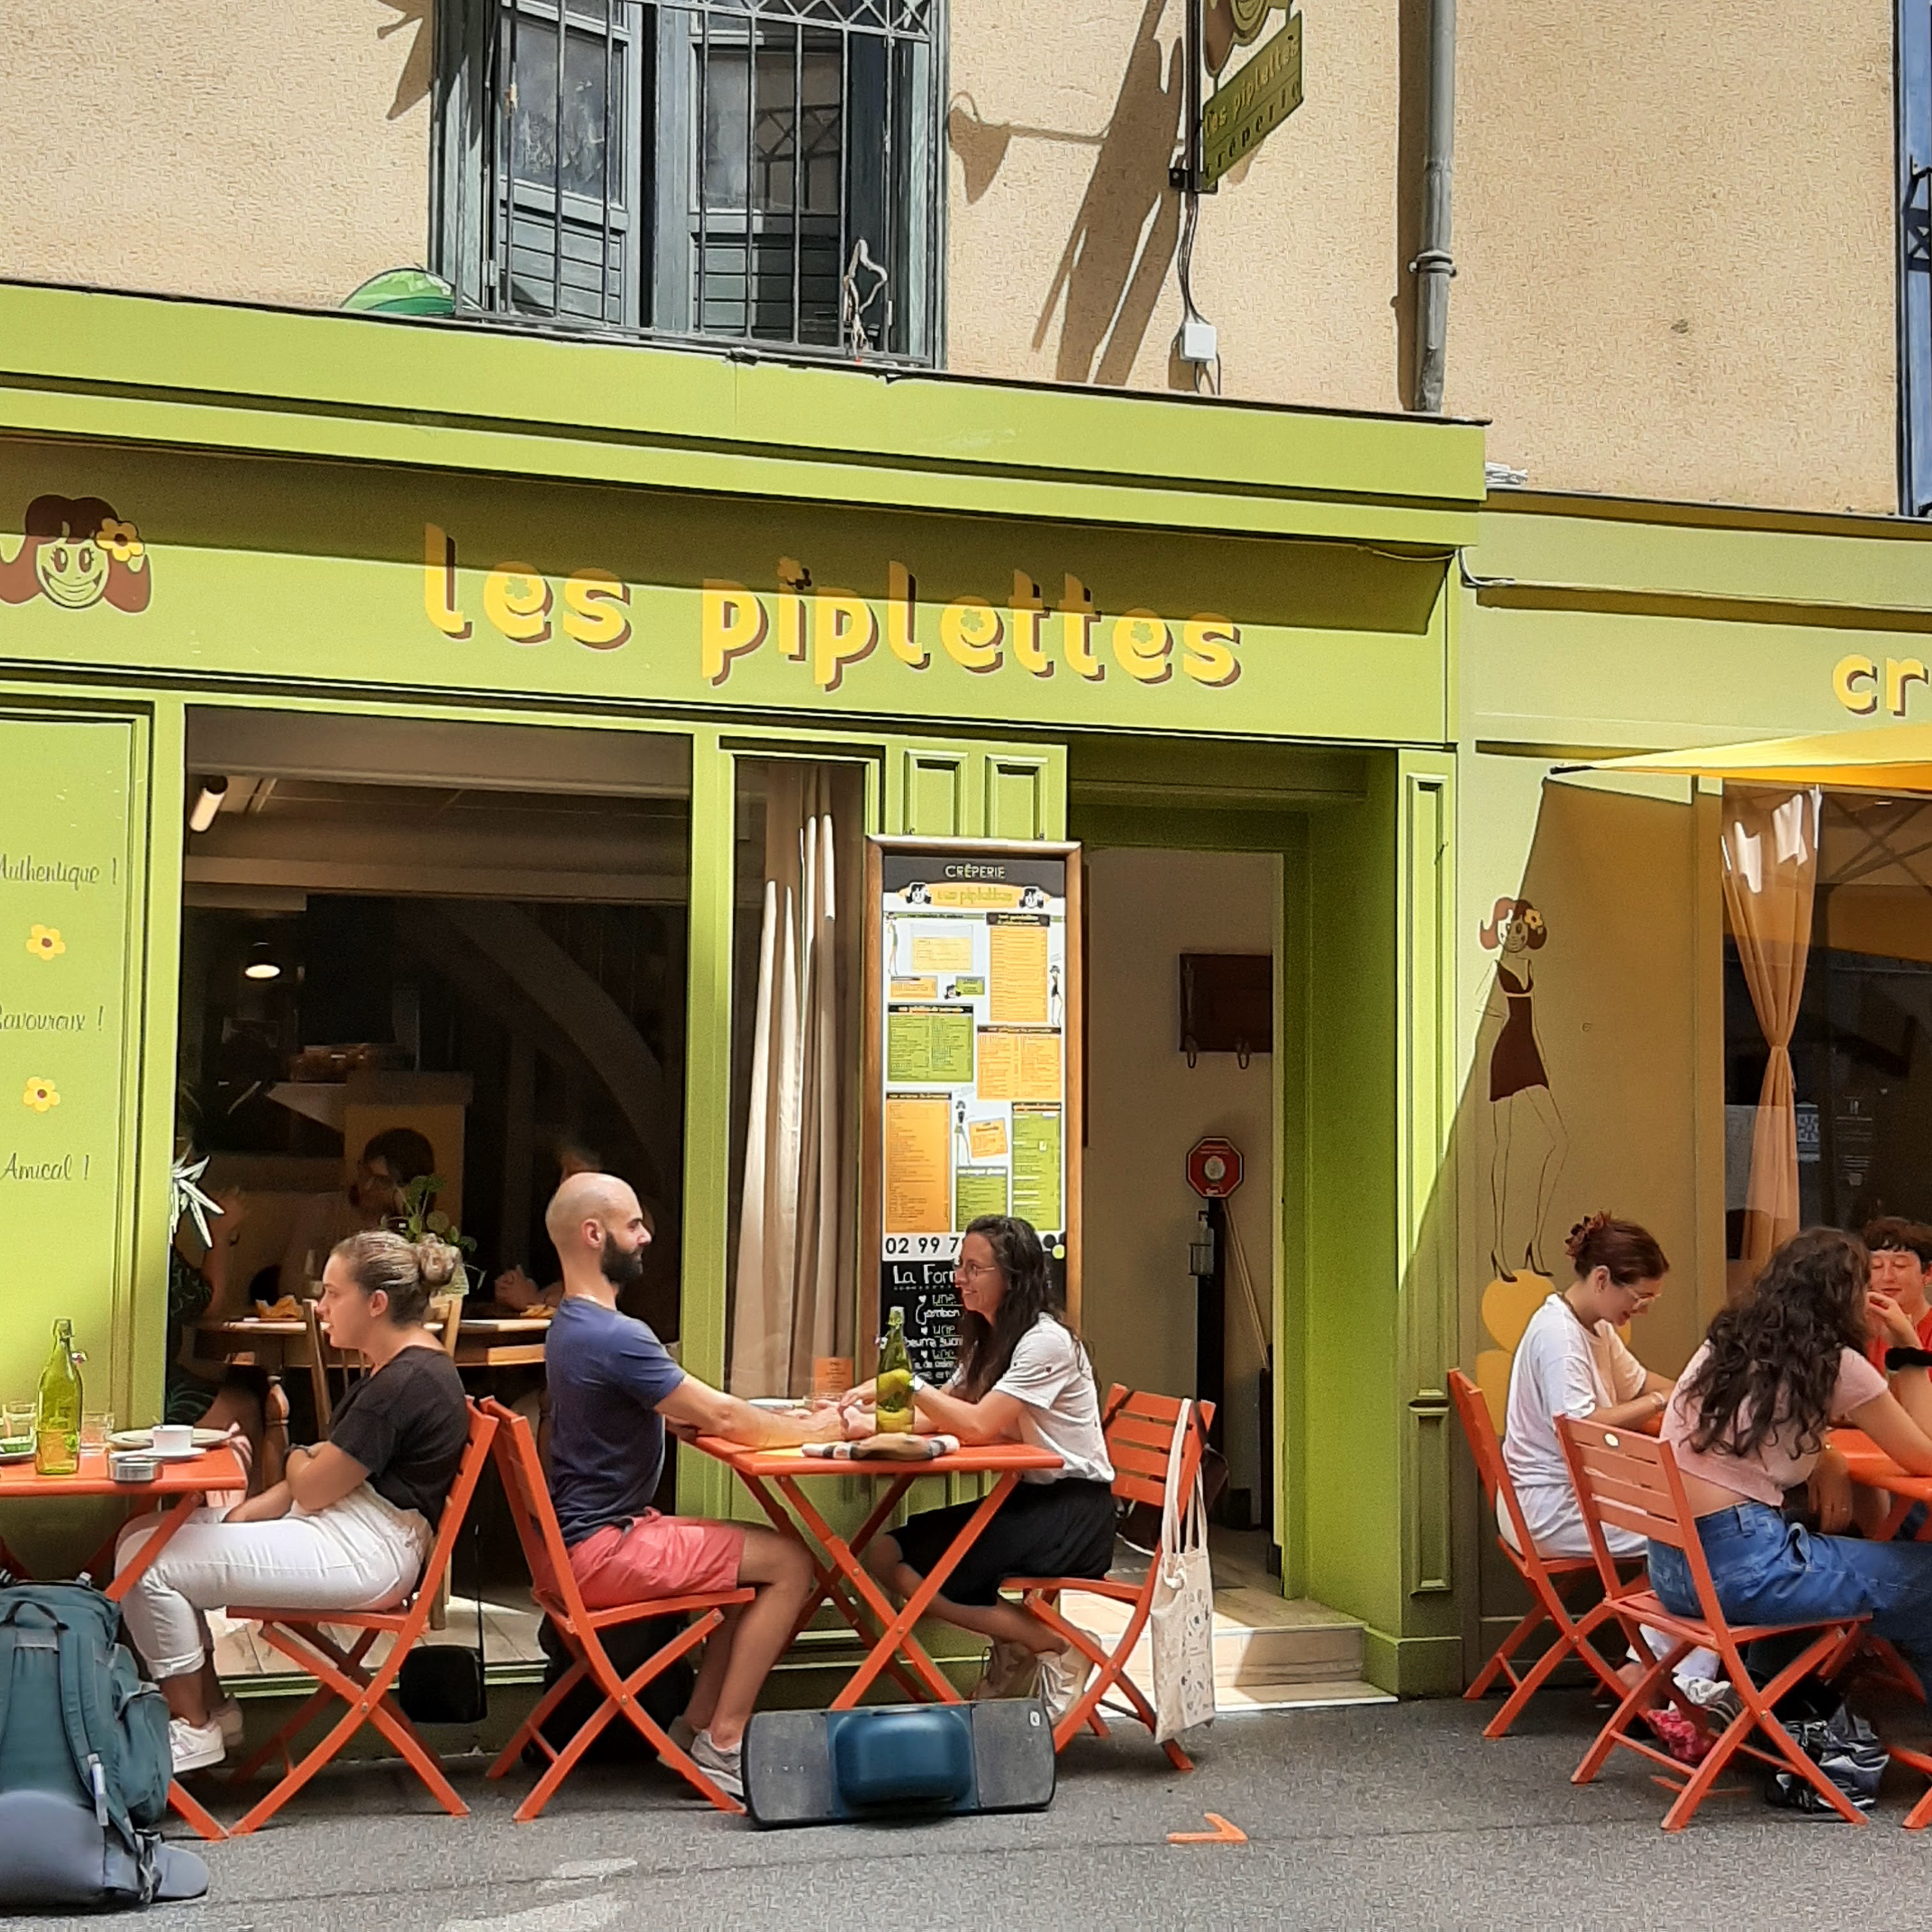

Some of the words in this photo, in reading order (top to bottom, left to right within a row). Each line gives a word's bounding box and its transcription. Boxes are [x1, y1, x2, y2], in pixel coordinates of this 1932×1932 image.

[424, 522, 632, 652] les
[702, 557, 1242, 693] piplettes
[944, 862, 1007, 879] CRÊPERIE
[0, 1005, 86, 1032] avoureux
[0, 1152, 72, 1181] Amical
[885, 1238, 909, 1254] 02
[918, 1237, 940, 1254] 99
[893, 1264, 917, 1284] La
